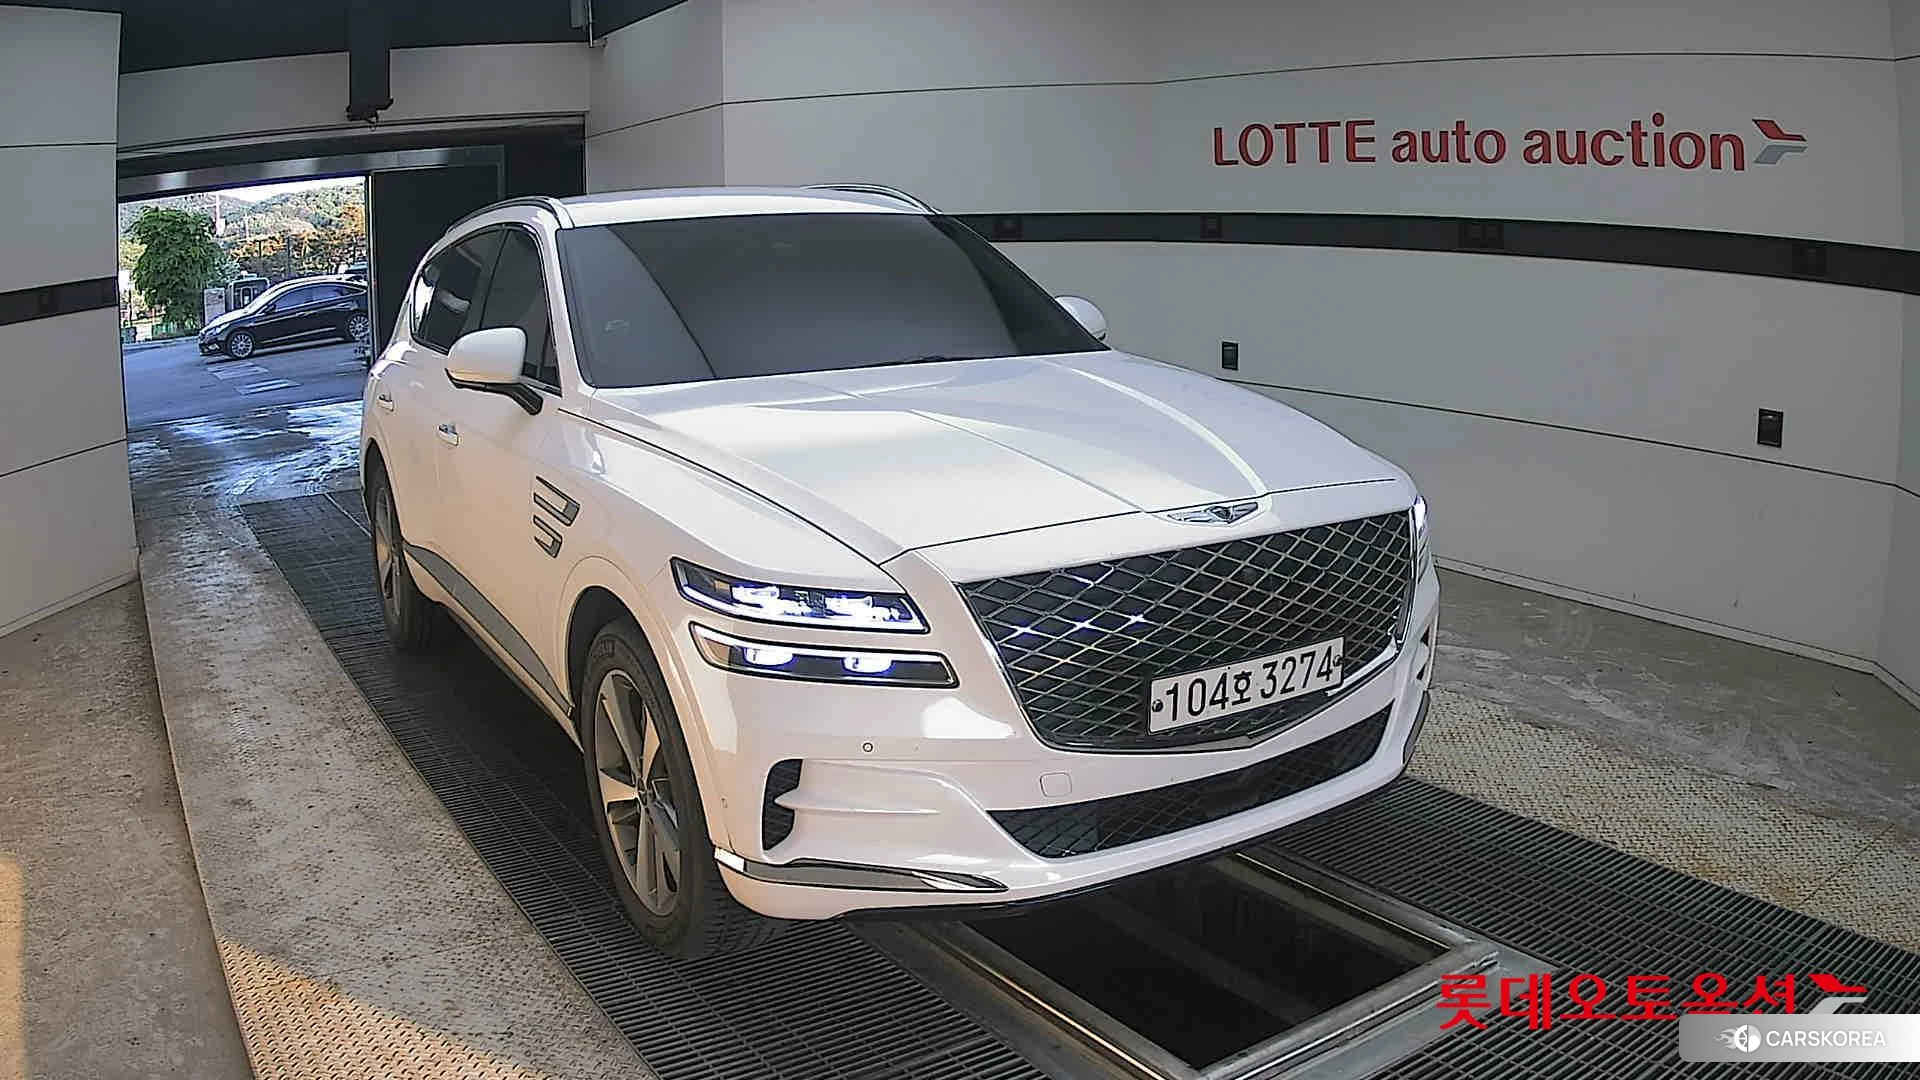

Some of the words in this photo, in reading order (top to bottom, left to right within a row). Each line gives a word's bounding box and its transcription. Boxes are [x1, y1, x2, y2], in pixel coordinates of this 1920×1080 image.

[1213, 119, 1376, 167] LOTTE
[1391, 119, 1507, 164] auto
[1522, 112, 1745, 171] auction
[1165, 670, 1252, 722] 104호
[1259, 645, 1334, 700] 3274
